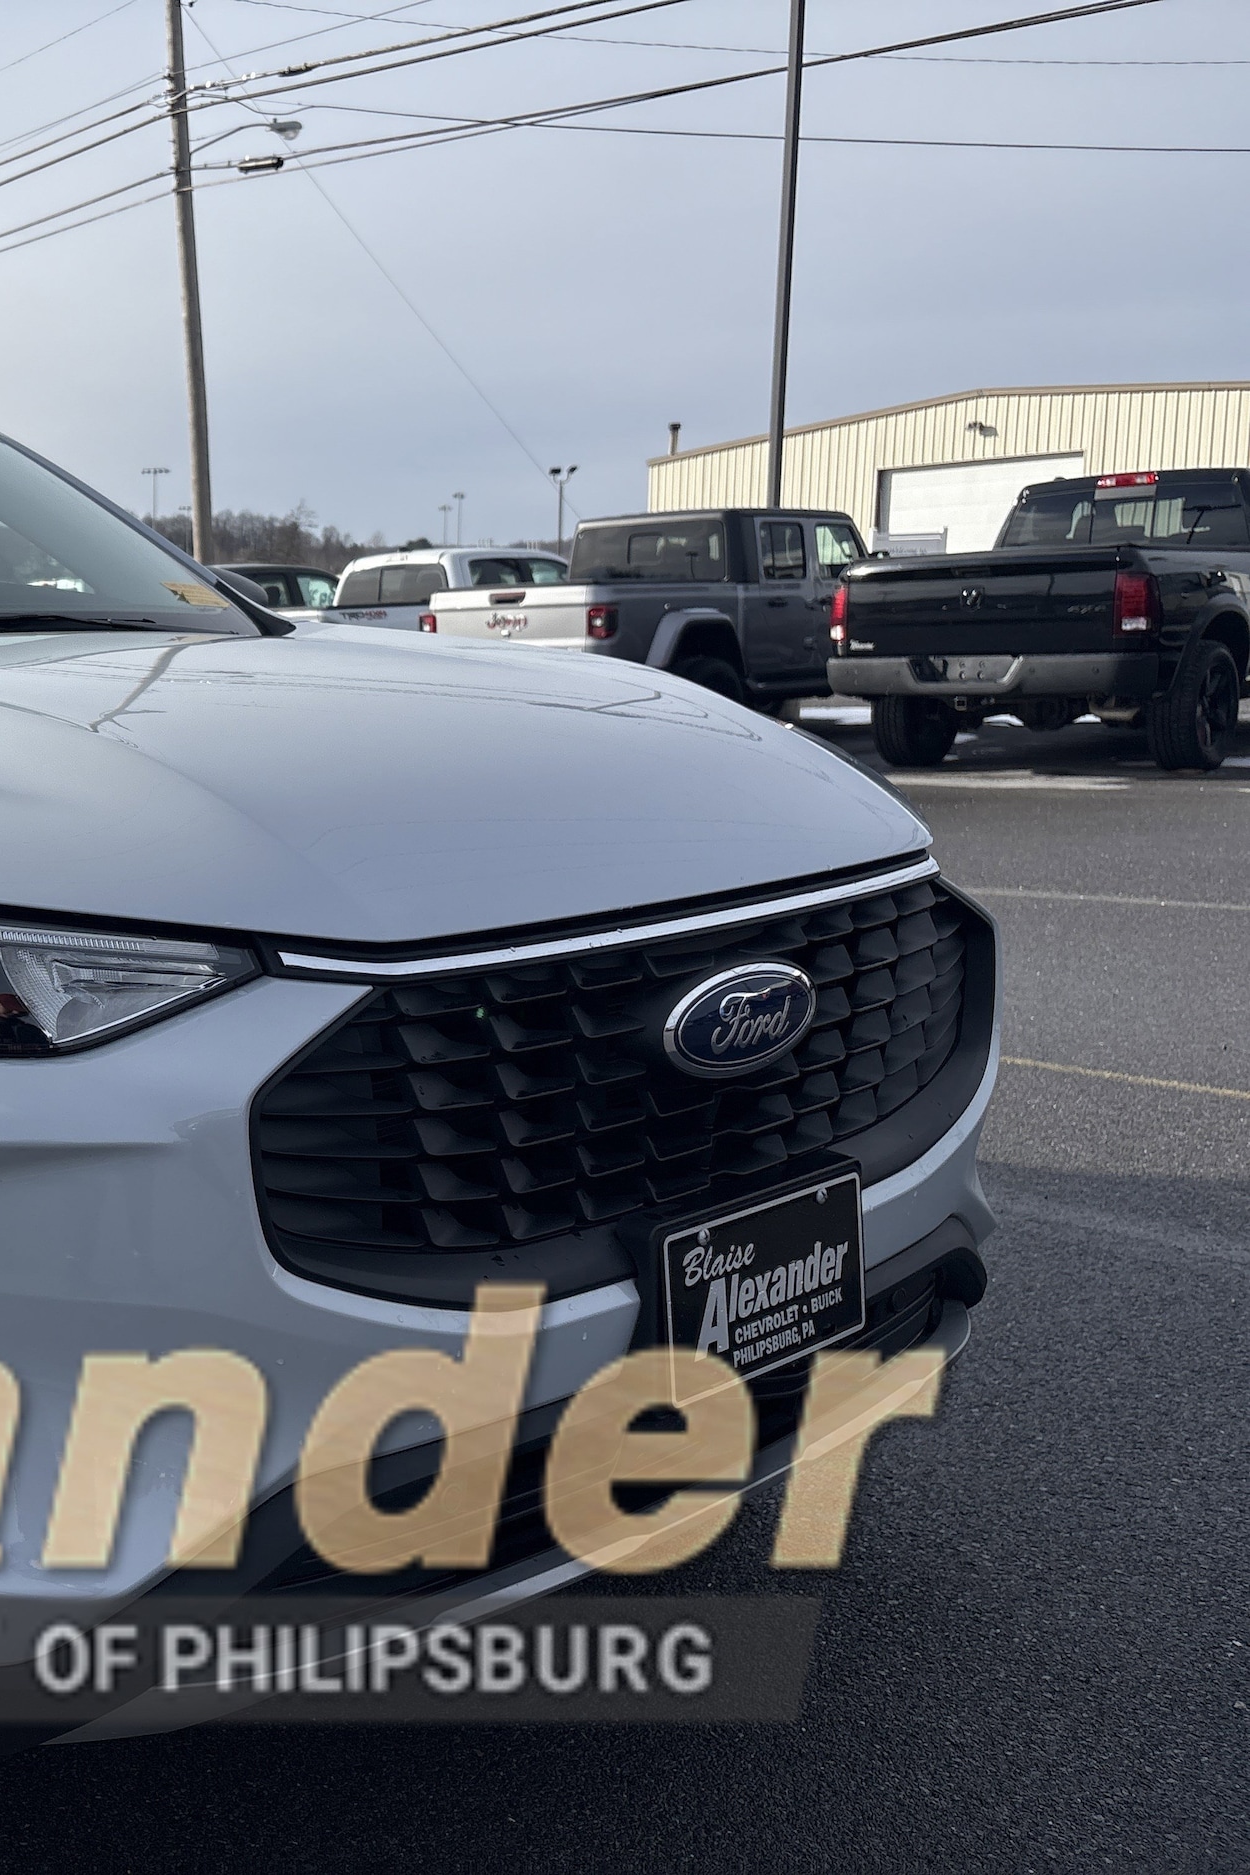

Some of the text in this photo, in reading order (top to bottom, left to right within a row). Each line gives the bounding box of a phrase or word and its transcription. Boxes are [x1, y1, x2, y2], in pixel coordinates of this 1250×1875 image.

[711, 987, 792, 1055] Ford
[682, 1243, 755, 1287] Blaise
[695, 1241, 848, 1362] Alexander
[734, 1287, 843, 1344] CHEVROLET BUICK
[733, 1319, 816, 1368] PHILIPSBURG, PA
